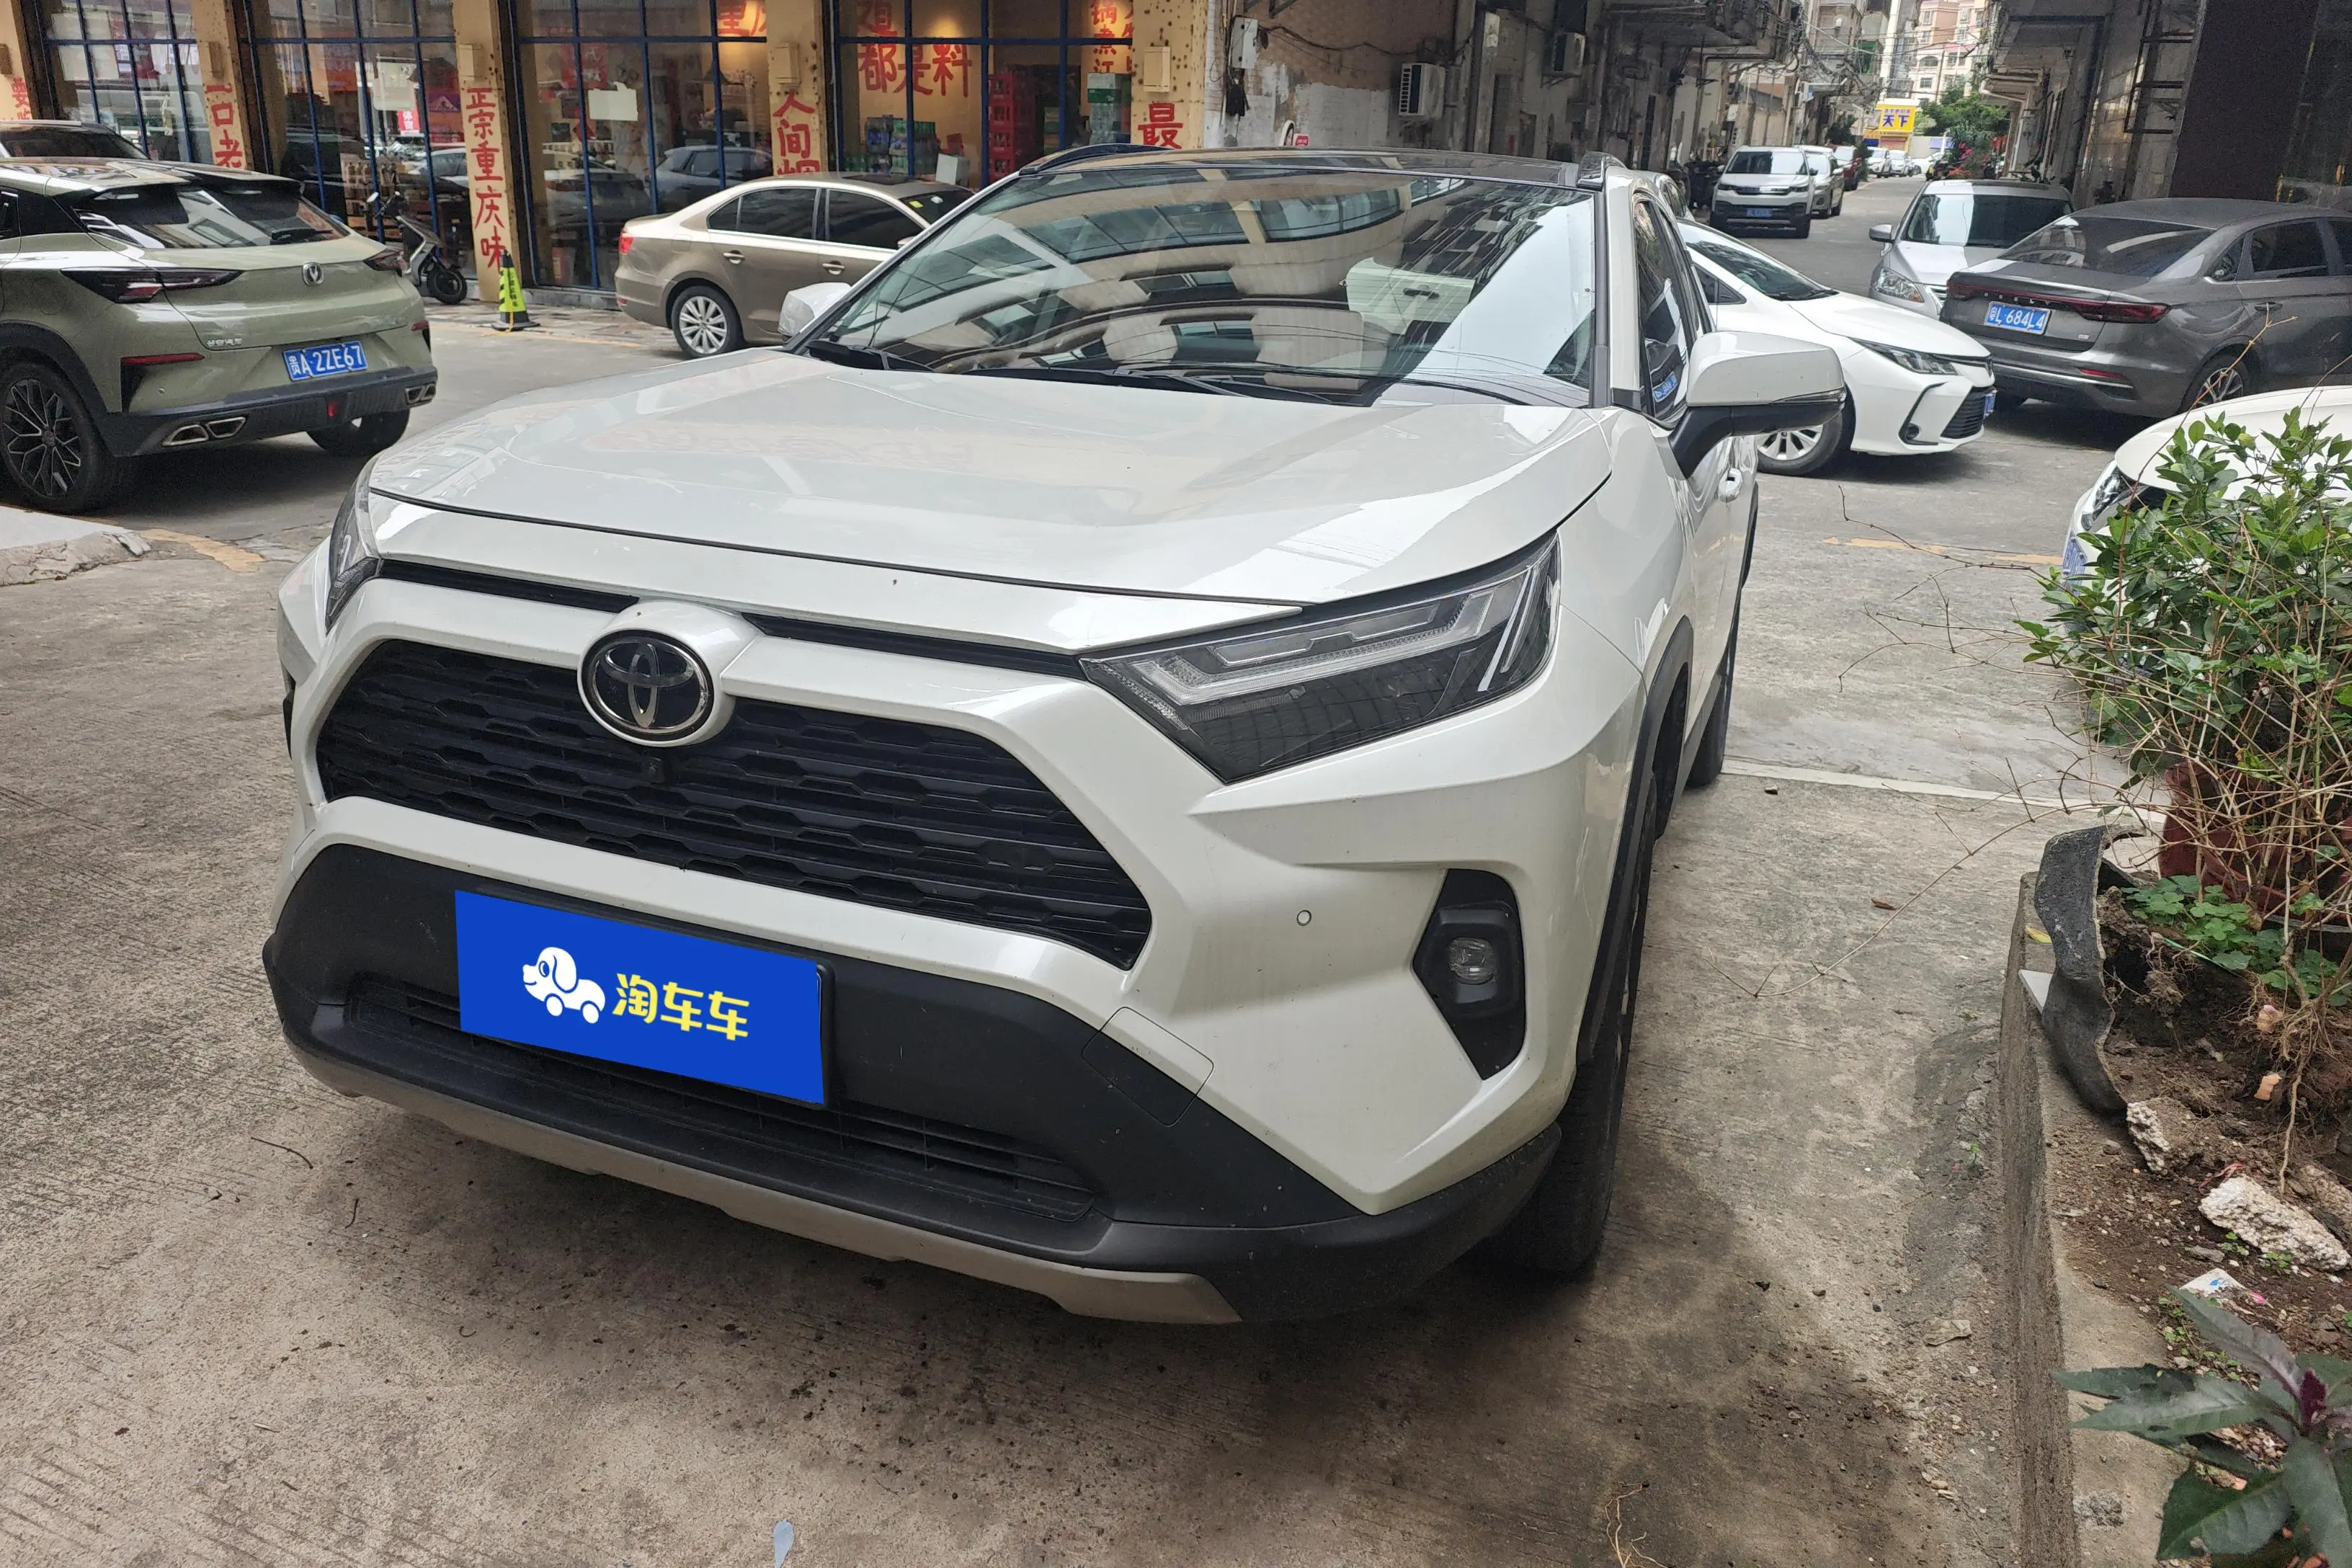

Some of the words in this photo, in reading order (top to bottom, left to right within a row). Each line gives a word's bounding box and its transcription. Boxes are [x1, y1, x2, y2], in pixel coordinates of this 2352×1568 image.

[206, 84, 243, 168] 一口老
[1138, 102, 1183, 149] 最
[1882, 115, 1910, 127] 天下
[466, 88, 506, 273] 正宗重庆味
